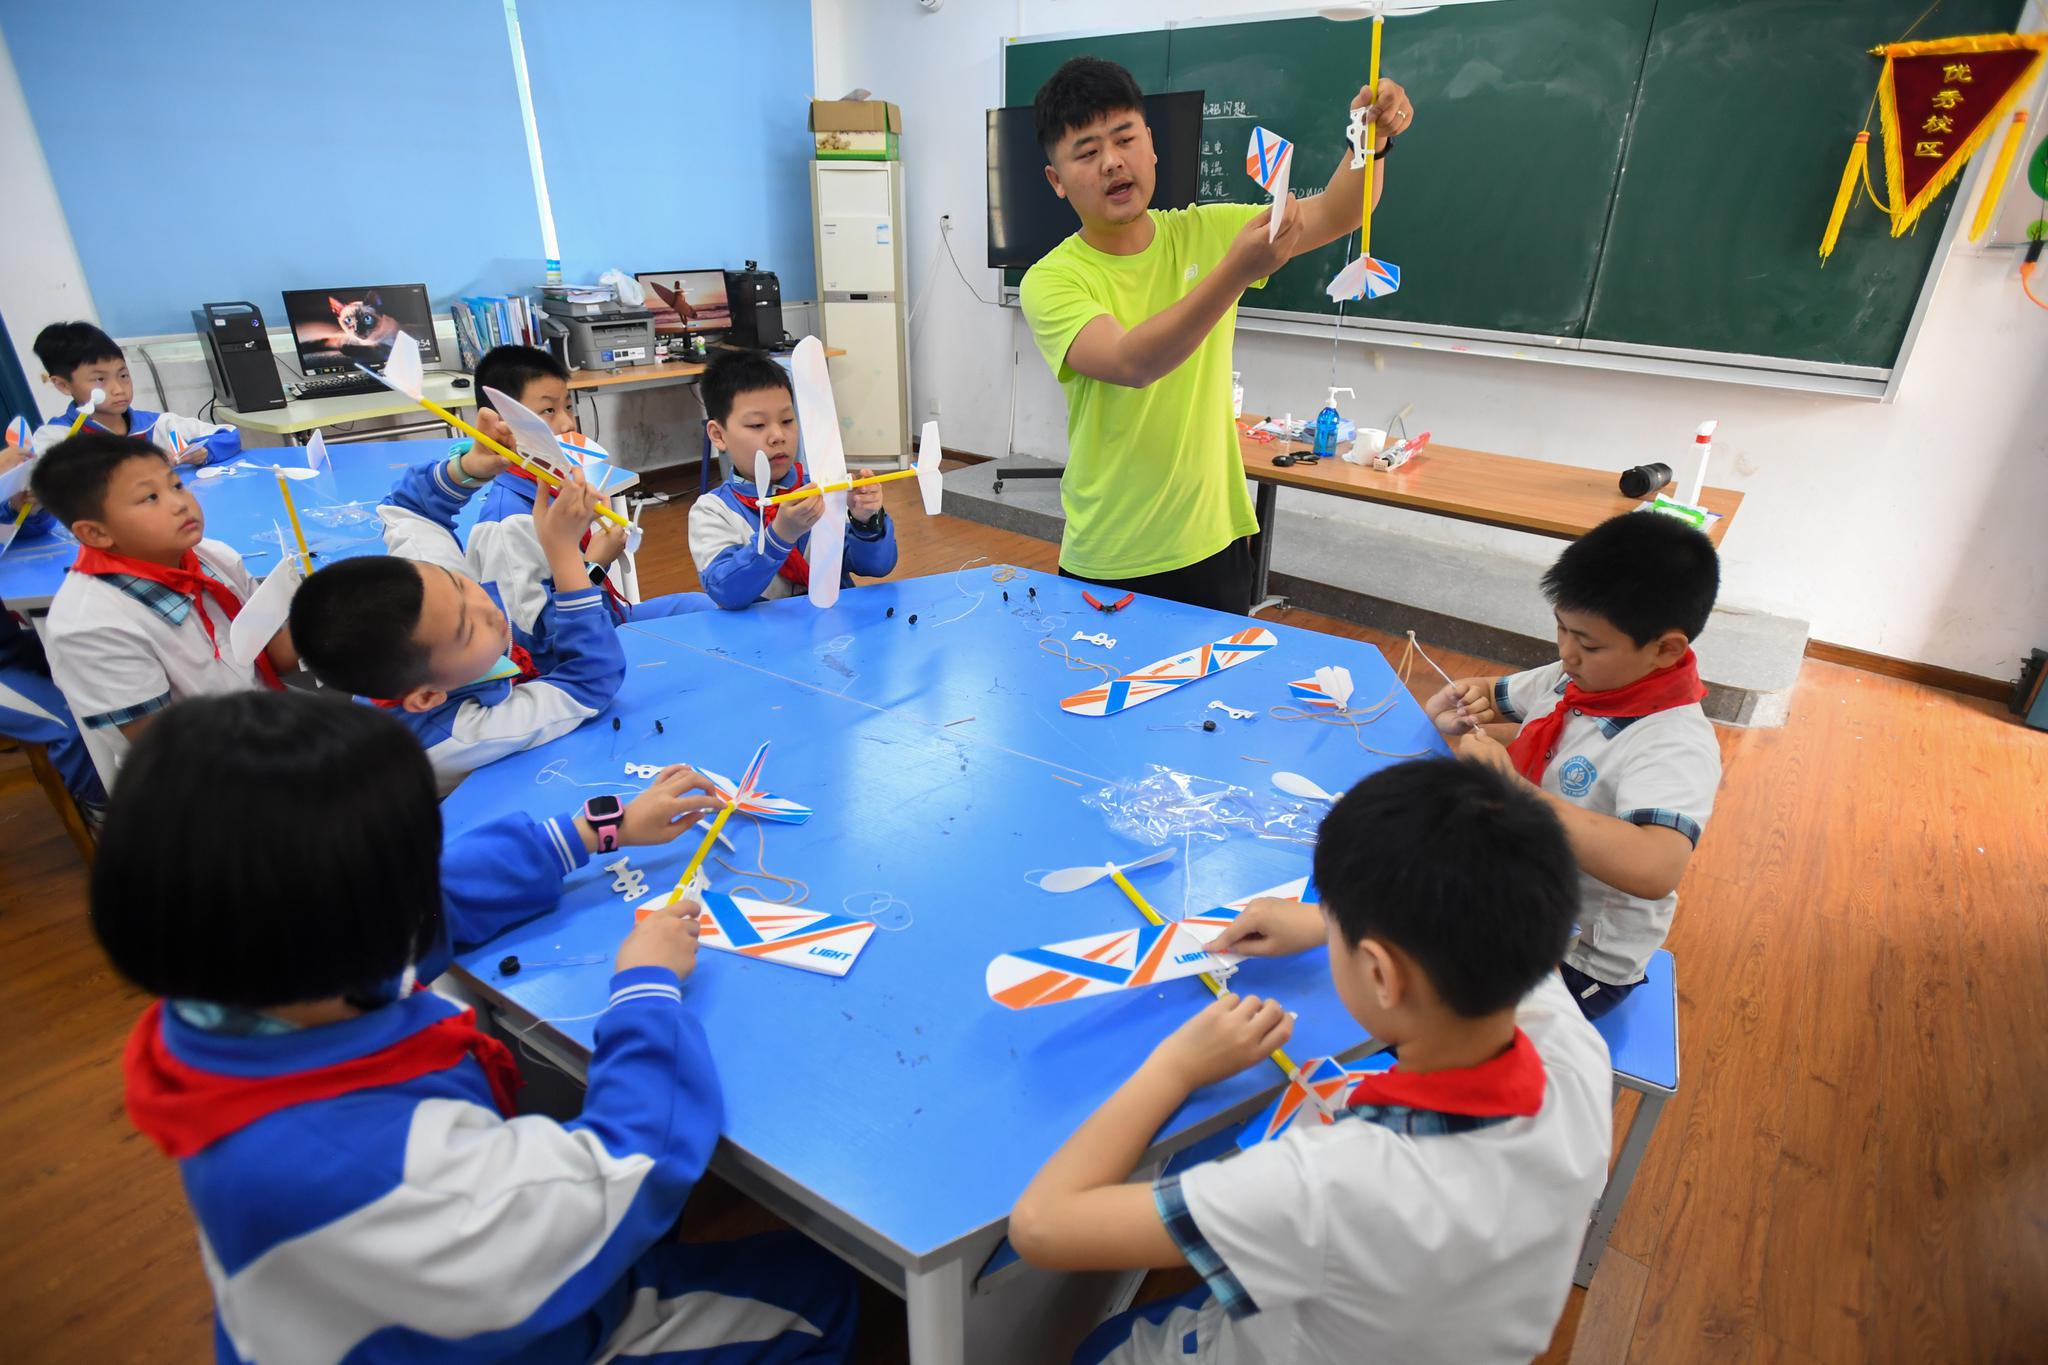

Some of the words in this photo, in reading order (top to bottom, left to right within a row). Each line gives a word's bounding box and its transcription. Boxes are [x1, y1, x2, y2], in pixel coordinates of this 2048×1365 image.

[1913, 64, 1974, 158] 优秀校区
[808, 946, 853, 961] LIGHT
[1173, 950, 1210, 964] LIGHT
